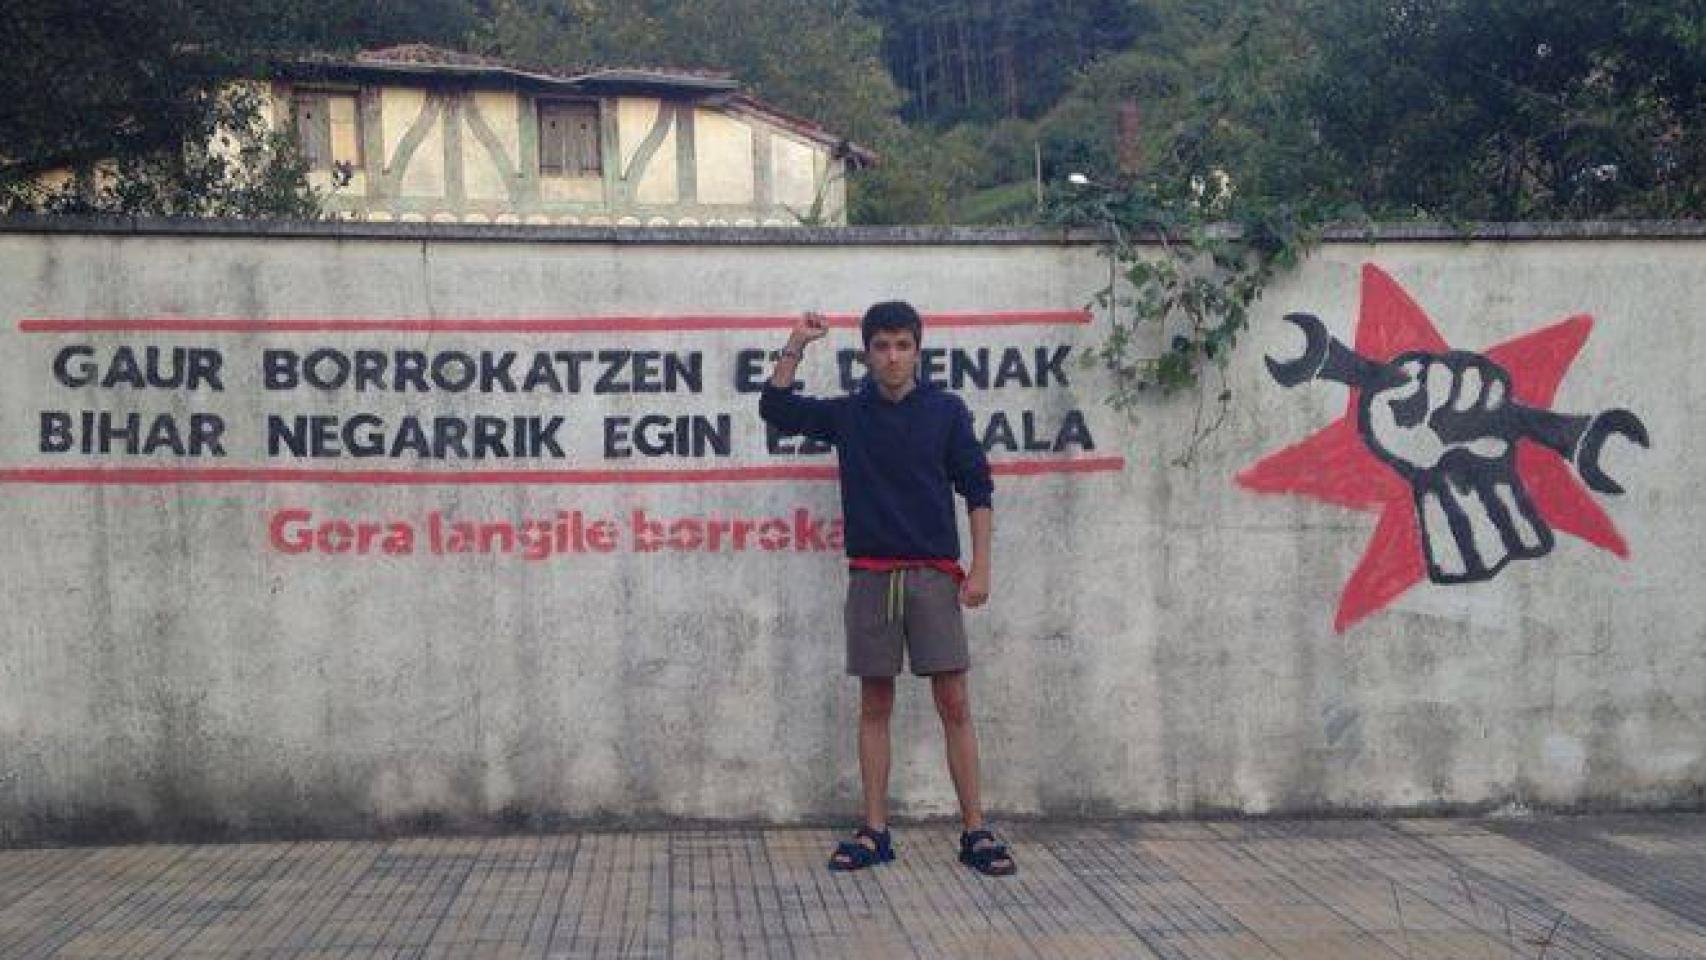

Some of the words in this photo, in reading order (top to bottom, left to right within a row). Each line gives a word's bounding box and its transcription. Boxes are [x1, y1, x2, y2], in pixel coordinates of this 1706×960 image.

[53, 346, 225, 391] GAUR
[264, 348, 704, 393] BORROKATZEN
[39, 411, 228, 456] BIHAR
[267, 414, 566, 459] NEGARRIK
[605, 414, 731, 457] EGIN
[268, 509, 414, 554] Gora
[428, 509, 617, 560] langile
